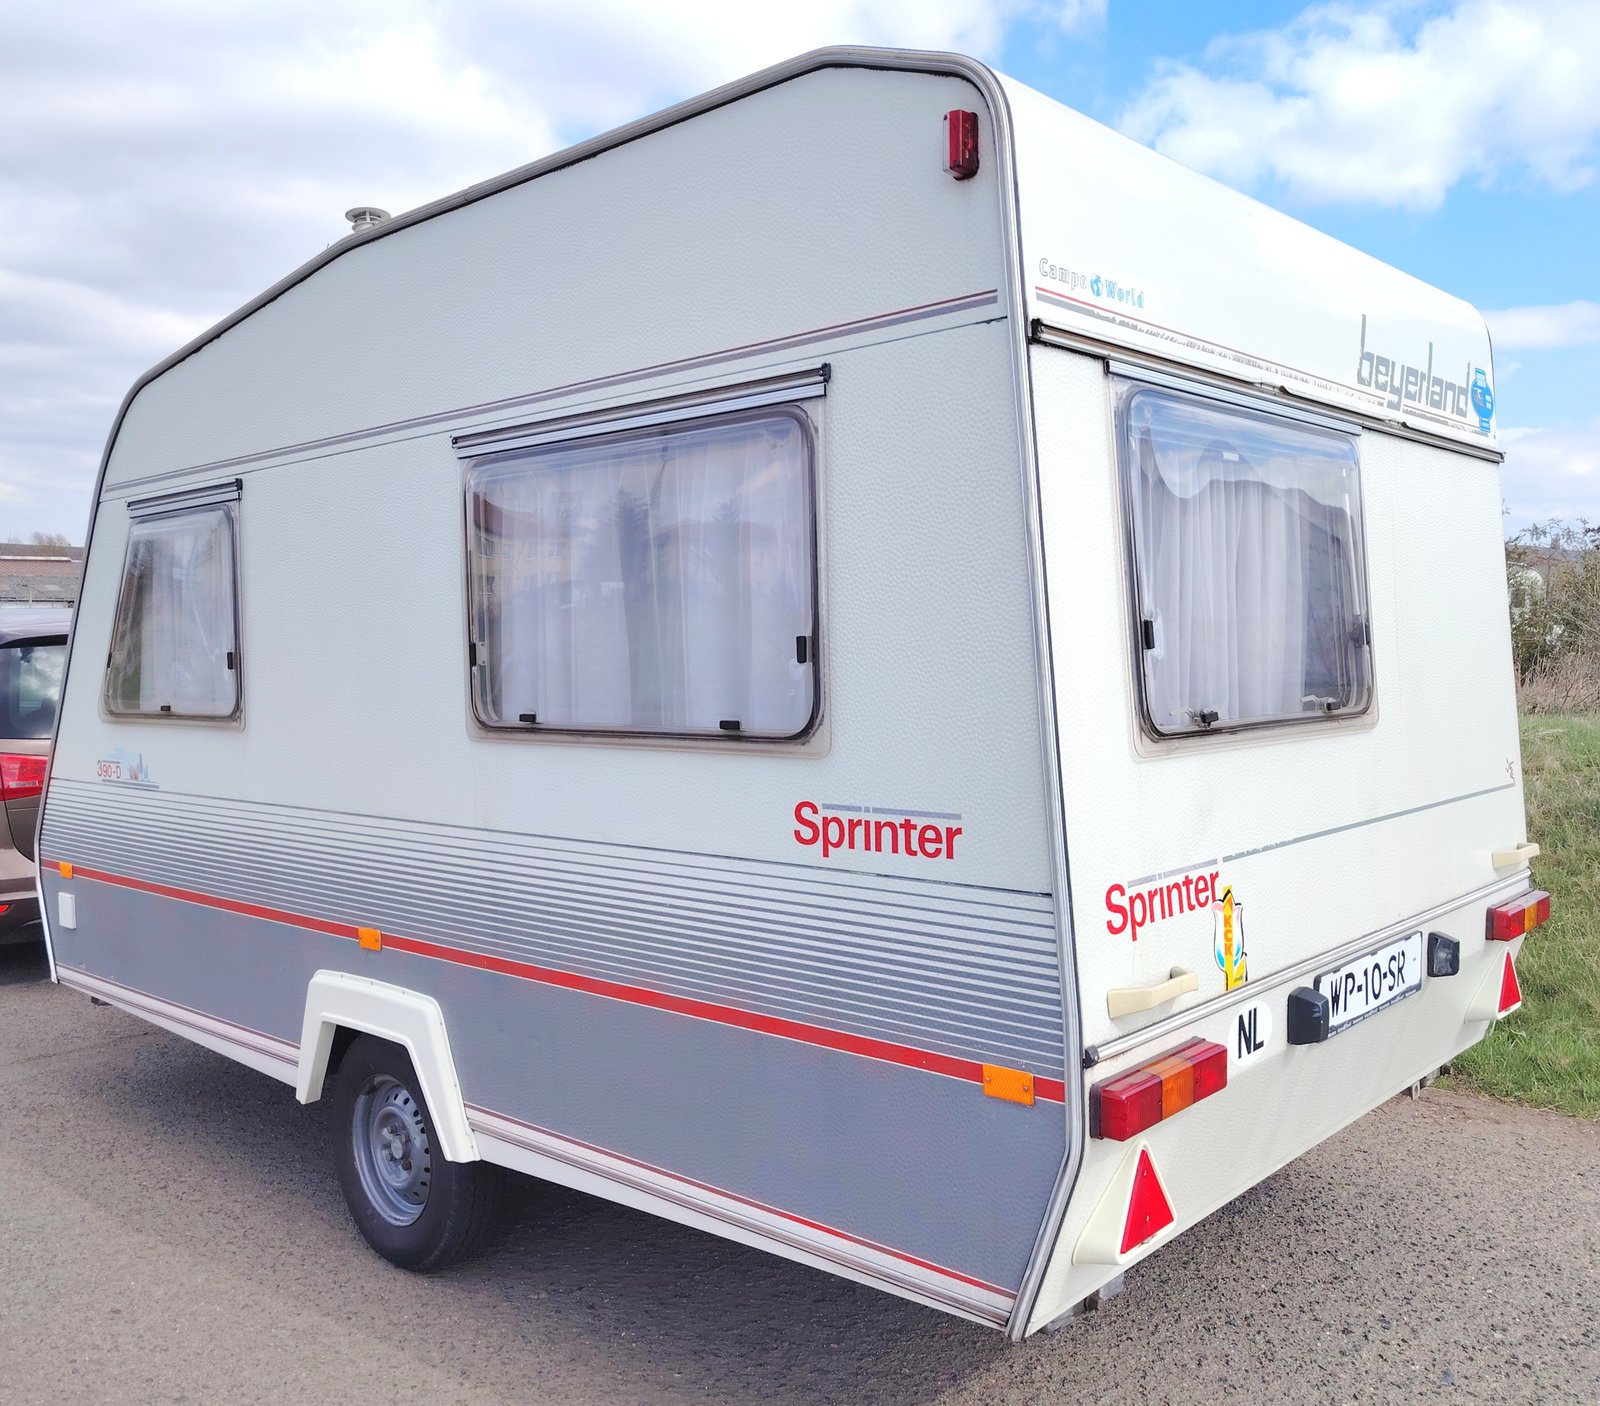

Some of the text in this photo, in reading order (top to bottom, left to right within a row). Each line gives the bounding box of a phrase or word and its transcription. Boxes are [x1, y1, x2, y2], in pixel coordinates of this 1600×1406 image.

[1039, 257, 1144, 309] Campo World
[1357, 314, 1471, 418] beyerland
[794, 801, 962, 860] Sprinter
[1105, 871, 1219, 942] Sprinter
[1330, 950, 1406, 1018] WP-10-SR
[1238, 1007, 1264, 1059] NL
